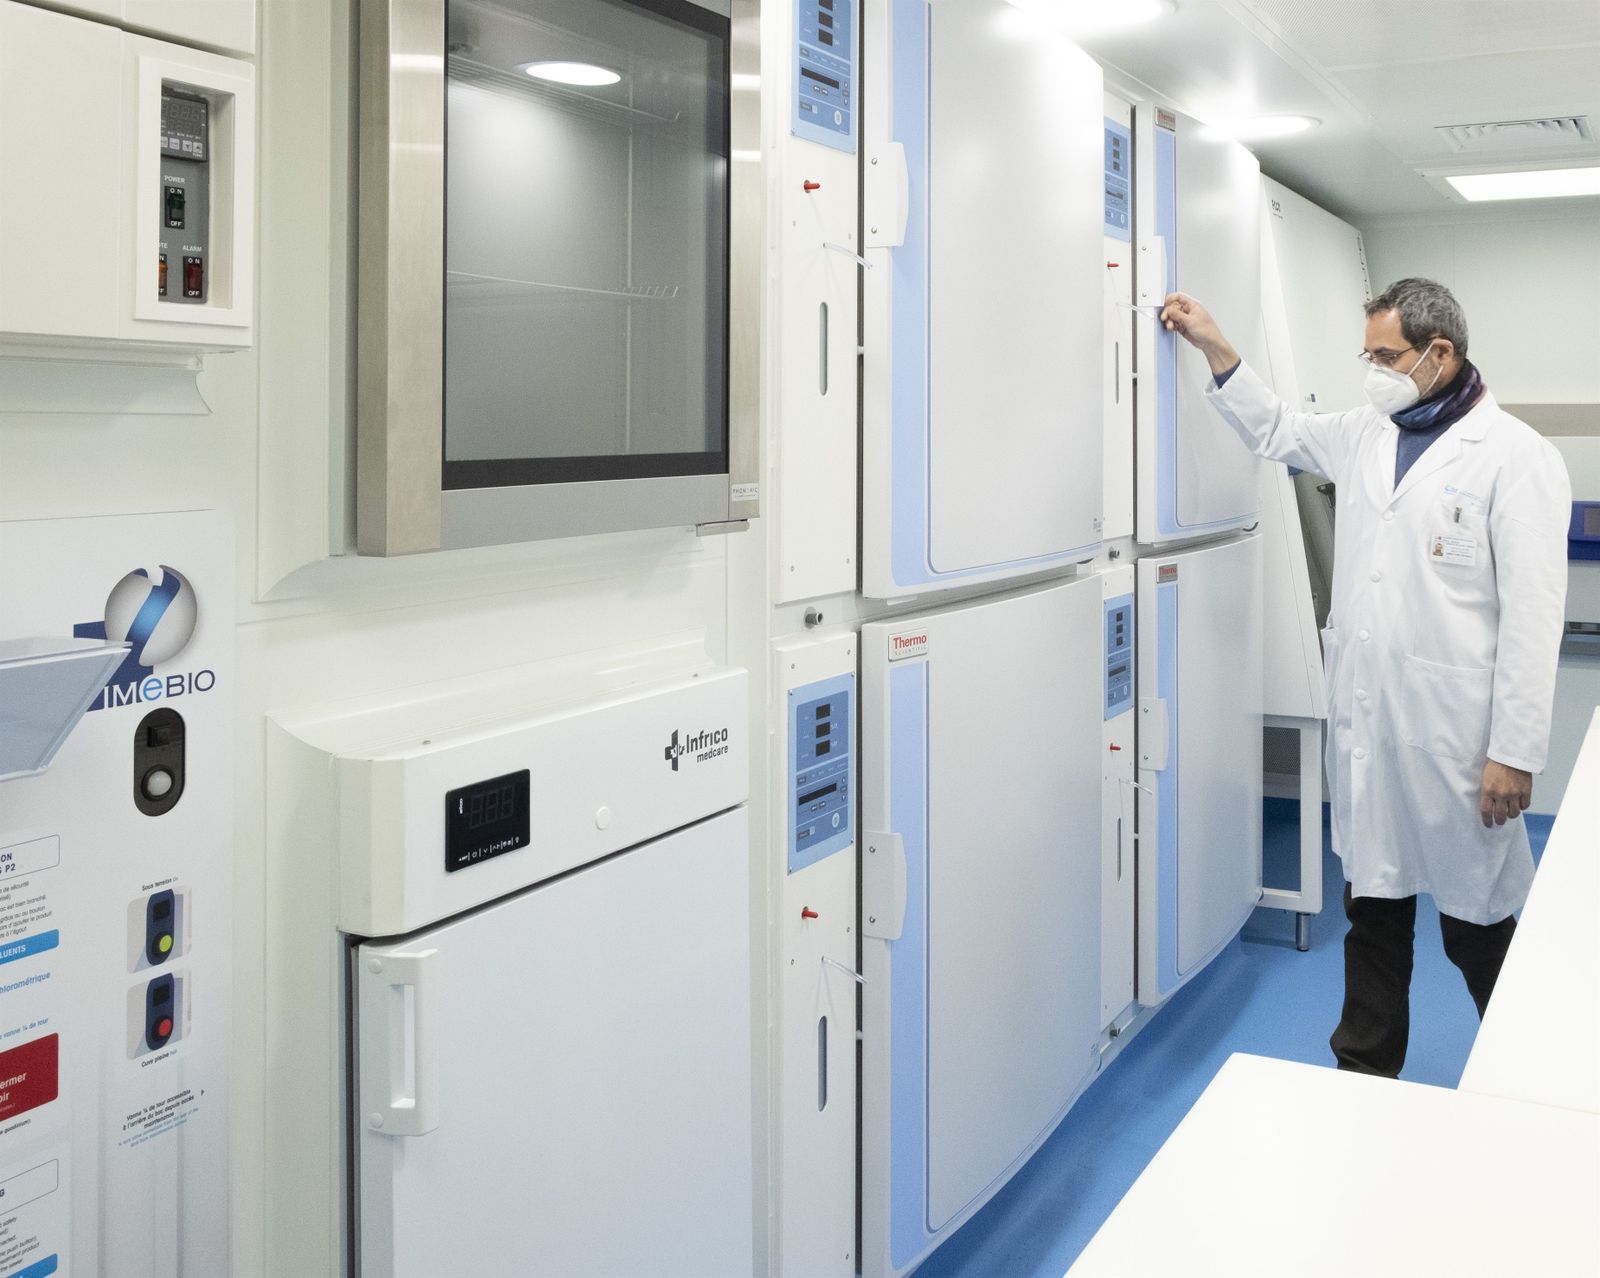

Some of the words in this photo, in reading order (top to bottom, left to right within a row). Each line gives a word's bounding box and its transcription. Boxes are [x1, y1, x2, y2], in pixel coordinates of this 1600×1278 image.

[164, 175, 185, 183] POWER
[893, 635, 927, 649] Thermo
[686, 728, 728, 755] Infrico
[696, 744, 729, 763] medcare
[5, 863, 16, 873] P2
